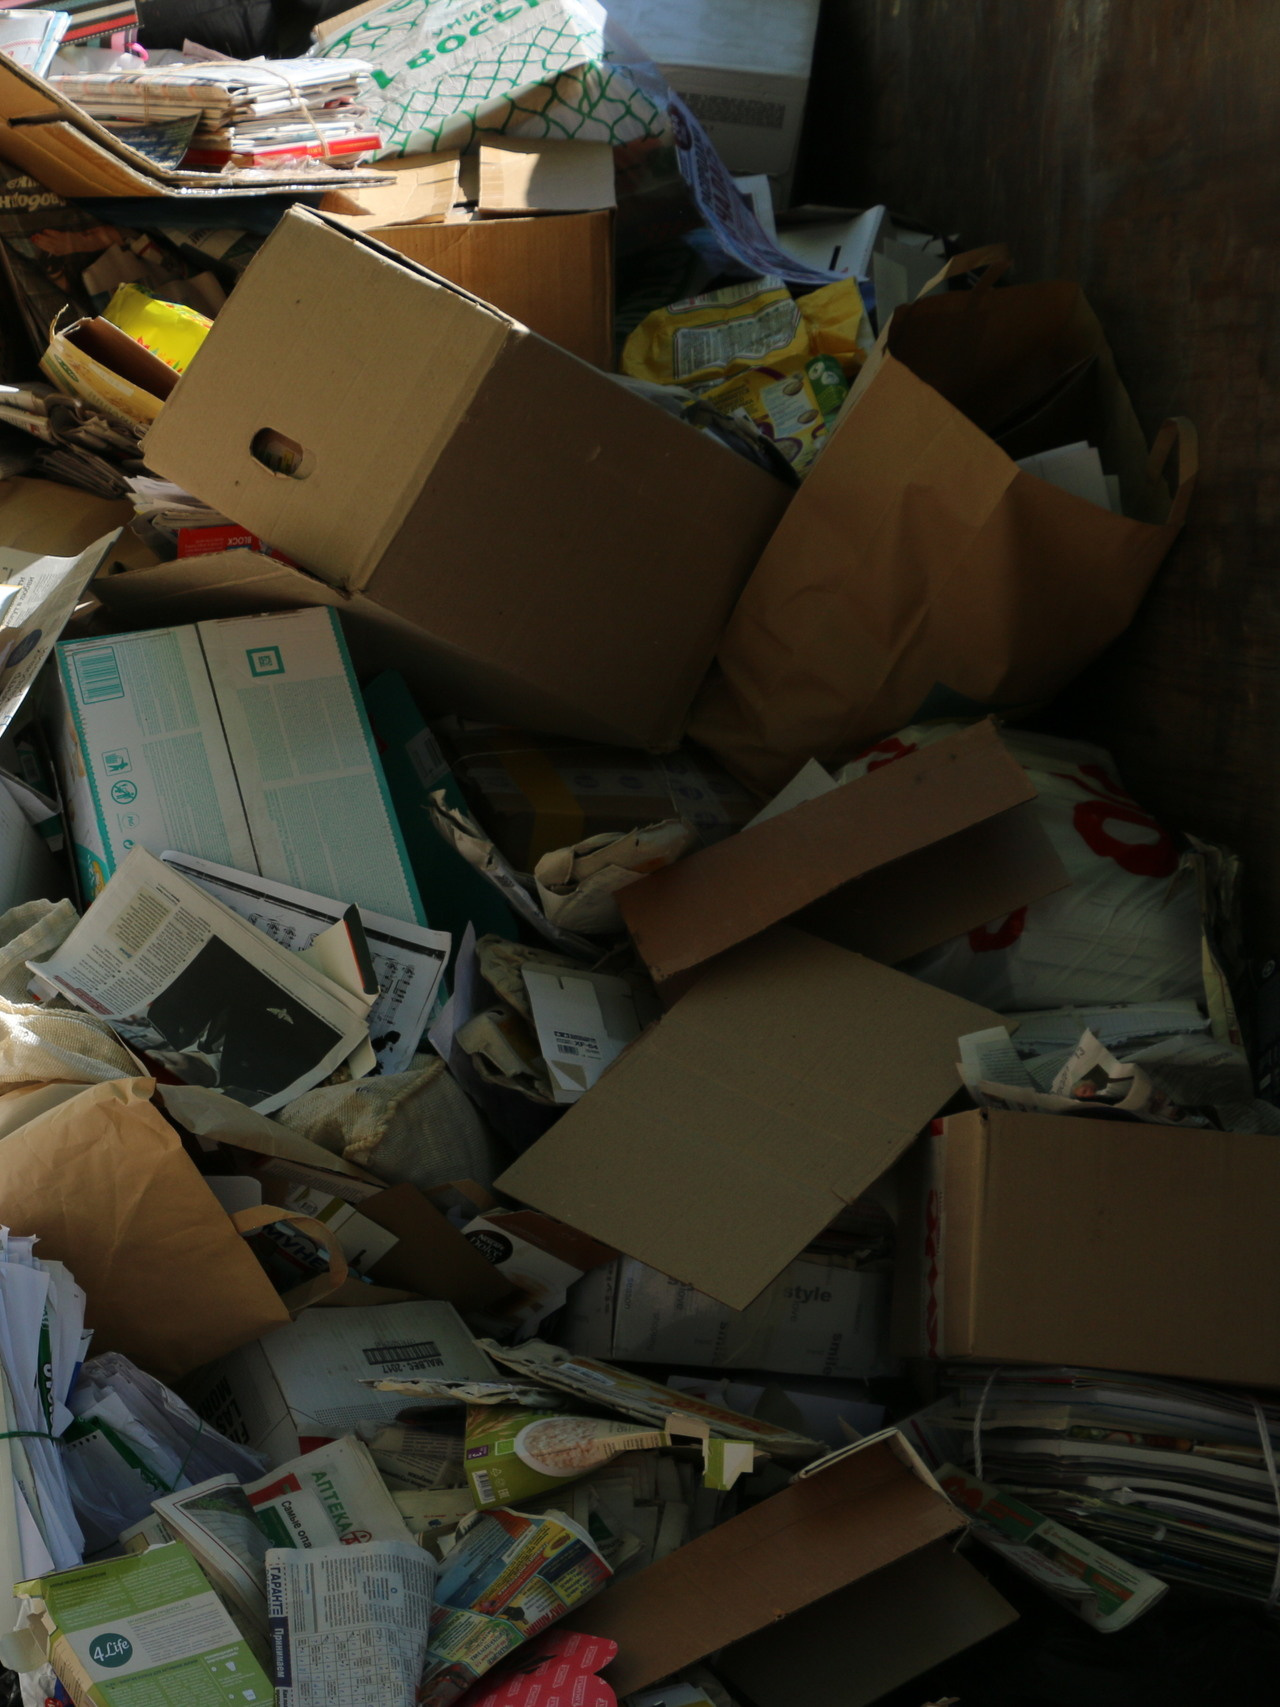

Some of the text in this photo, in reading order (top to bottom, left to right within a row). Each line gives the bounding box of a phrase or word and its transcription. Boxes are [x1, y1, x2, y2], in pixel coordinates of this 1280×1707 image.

[783, 1283, 833, 1307] style
[382, 1360, 403, 1375] 2017
[414, 1356, 445, 1373] MALBEC
[823, 1331, 842, 1378] smile
[281, 1499, 302, 1531] Самые
[311, 1469, 354, 1533] АПТЕКА
[91, 1637, 132, 1665] 4Life
[273, 1627, 286, 1679] Принимаем
